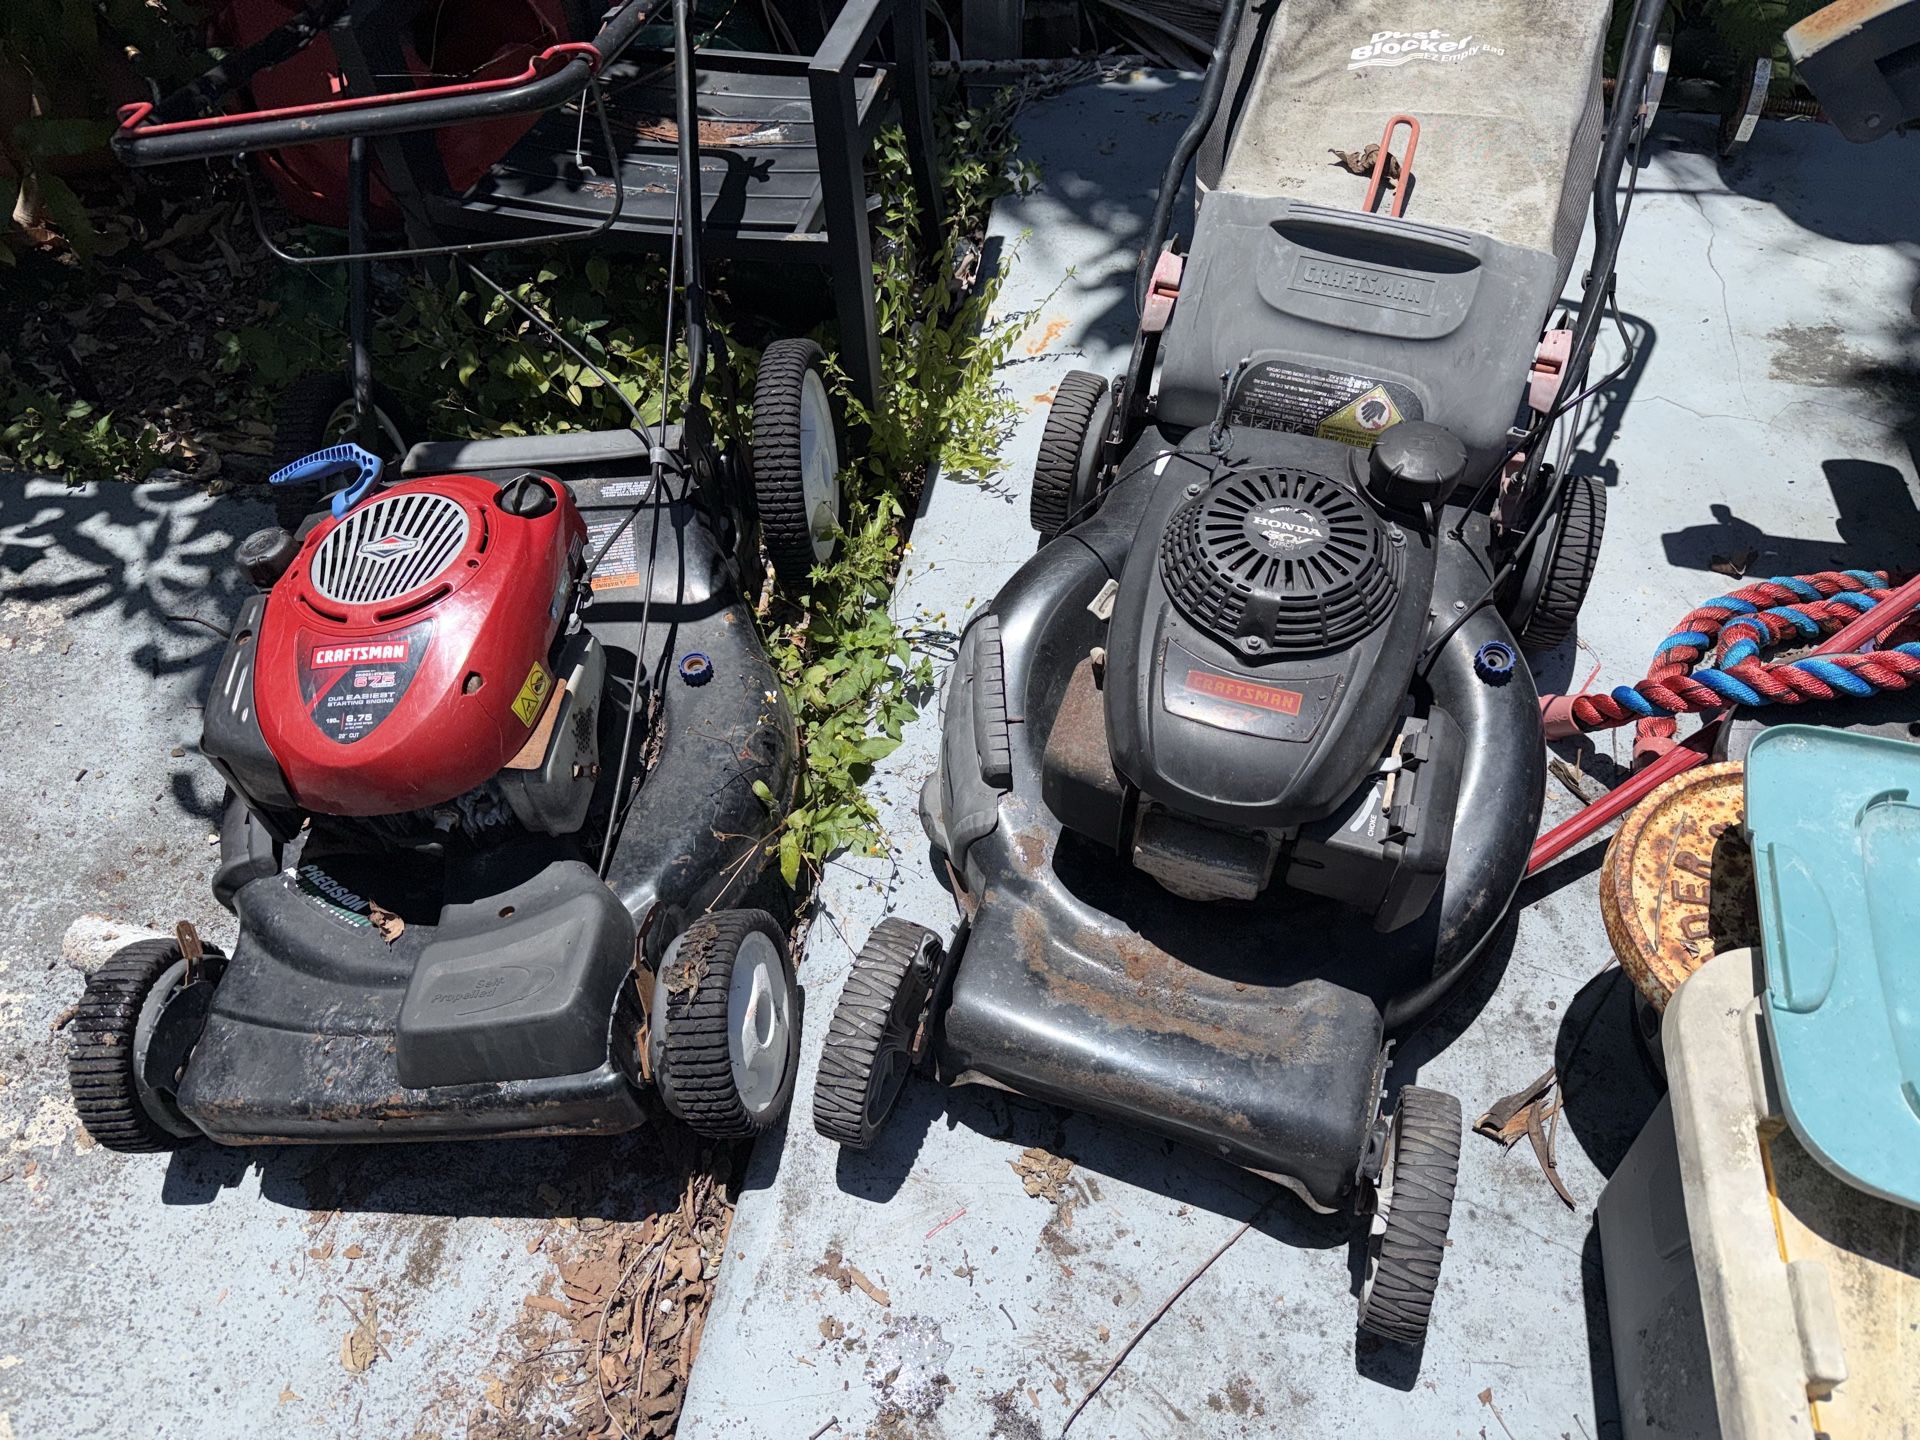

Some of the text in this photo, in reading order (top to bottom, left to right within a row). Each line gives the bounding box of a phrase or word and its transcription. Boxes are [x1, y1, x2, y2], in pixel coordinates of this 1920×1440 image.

[1370, 29, 1450, 44] Dust-
[1350, 35, 1473, 60] Blocker
[1440, 45, 1480, 63] Empty
[1482, 44, 1505, 56] Bag
[1302, 263, 1425, 304] CRAFTSMAN
[1252, 516, 1323, 537] HONDA
[316, 645, 404, 664] CRAFTSMAN
[346, 692, 395, 700] EASIEST
[1193, 676, 1294, 709] CRAFTSMAN
[327, 699, 364, 707] STARTING
[346, 713, 372, 722] 6.75
[1367, 814, 1378, 837] CHOKE
[300, 864, 369, 911] PRECISION
[431, 988, 496, 1003] Propelled
